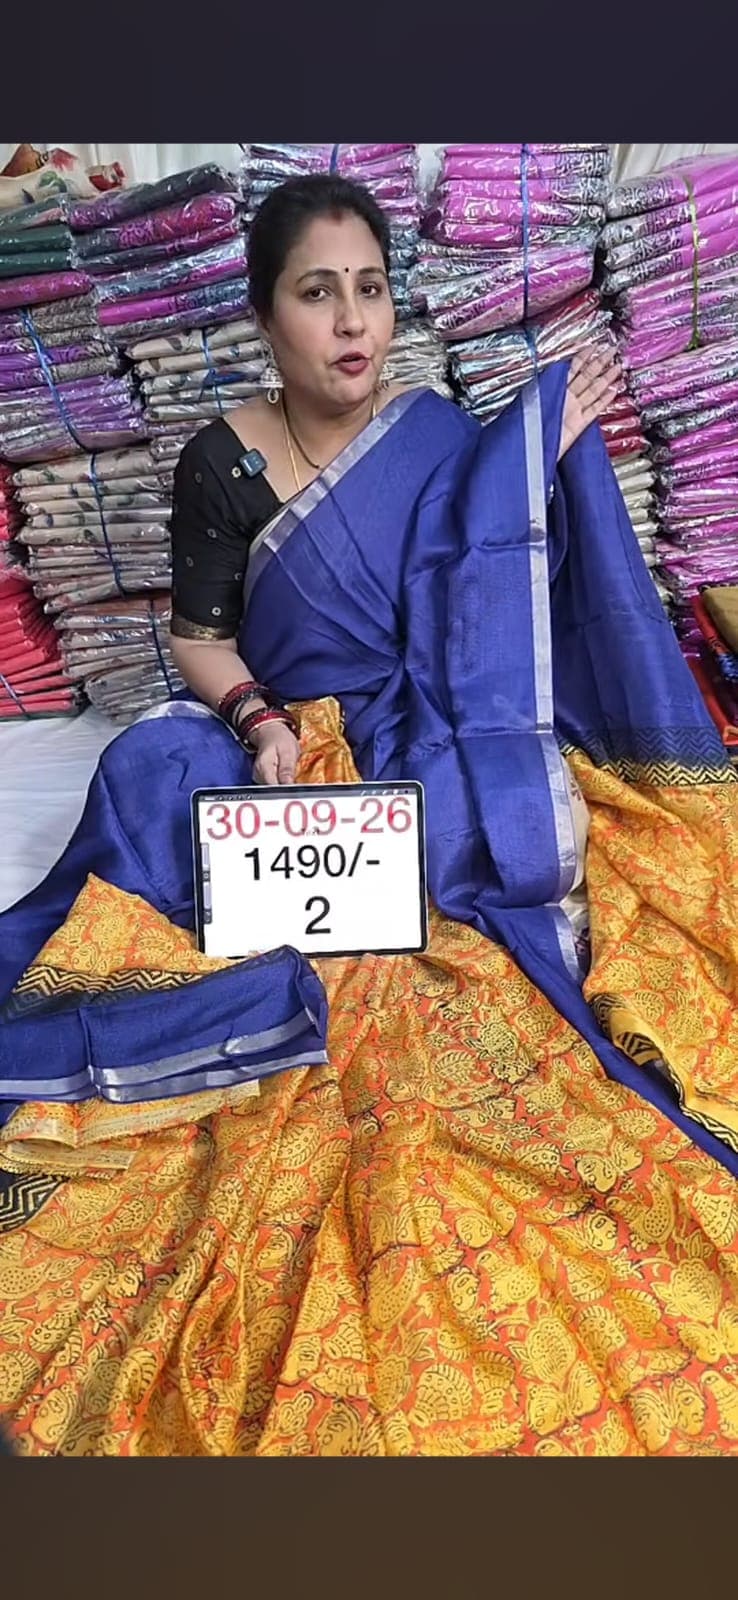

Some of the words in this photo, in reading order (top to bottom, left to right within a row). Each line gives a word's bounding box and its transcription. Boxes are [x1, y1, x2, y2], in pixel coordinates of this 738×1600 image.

[206, 797, 412, 840] 30-09-26
[244, 842, 380, 881] 1490/-
[304, 895, 332, 935] 2
